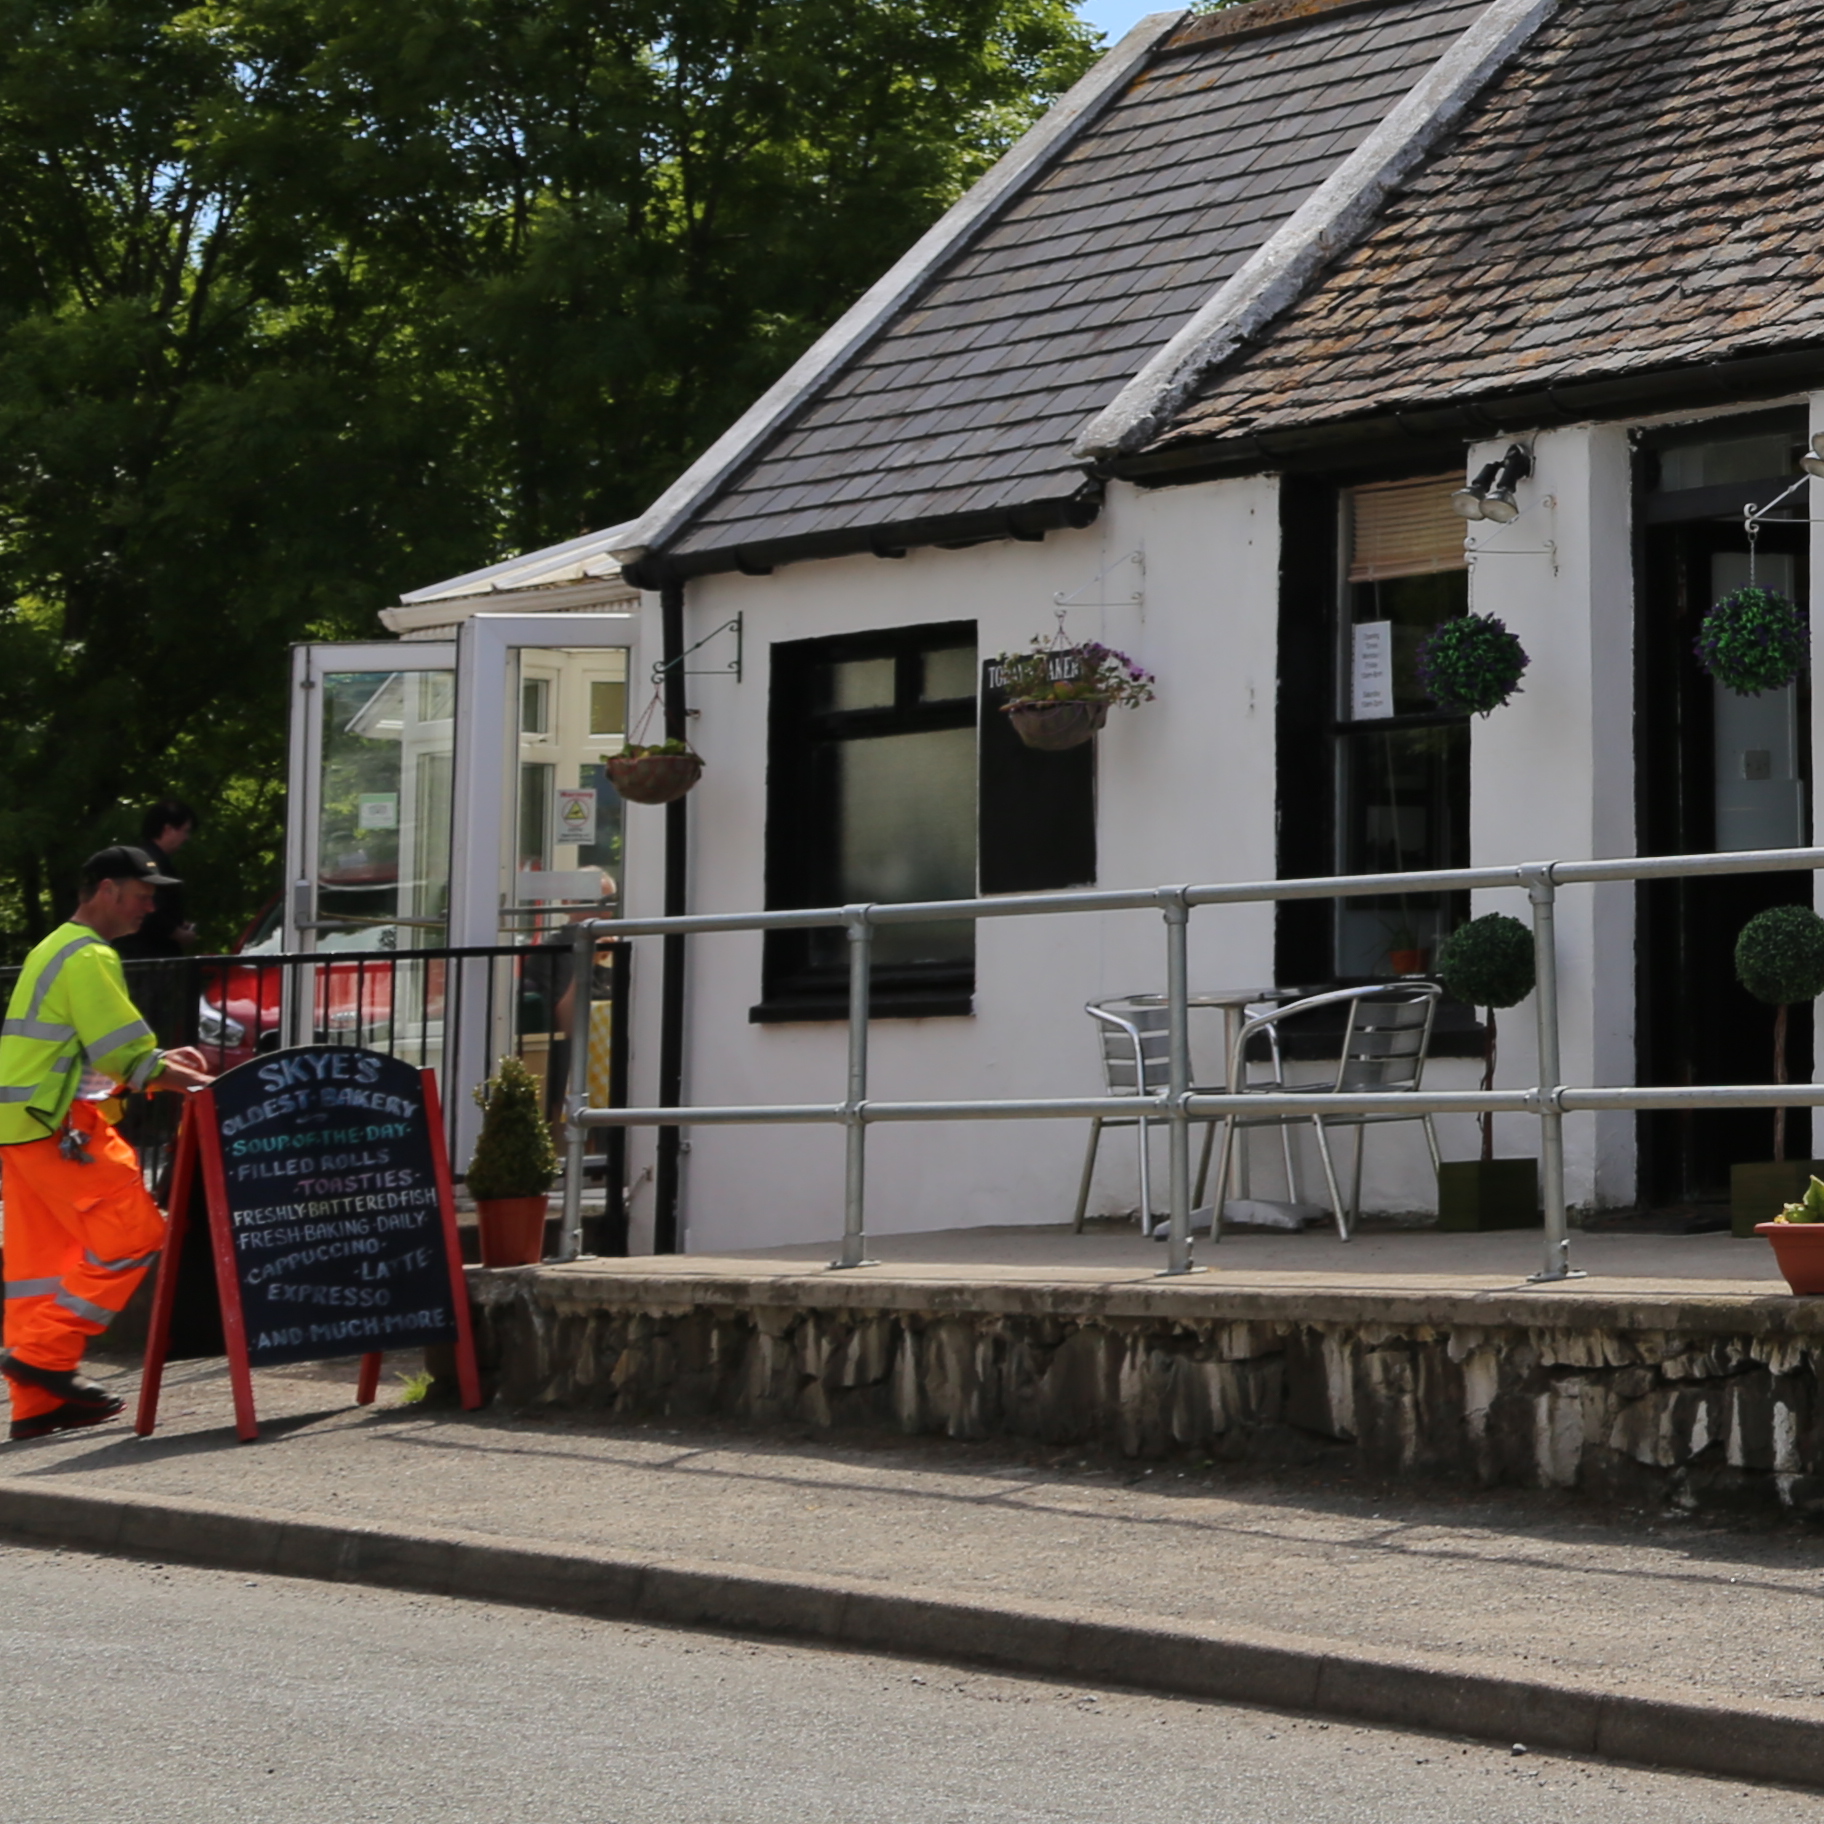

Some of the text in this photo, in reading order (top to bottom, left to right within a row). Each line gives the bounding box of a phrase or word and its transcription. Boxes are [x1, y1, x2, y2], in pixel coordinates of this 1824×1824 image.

[257, 1052, 383, 1092] SKYE'S
[221, 1087, 418, 1136] OLDEST BAKERY
[237, 1149, 390, 1181] FILLED ROLLS
[267, 1283, 391, 1307] EXPRESSO
